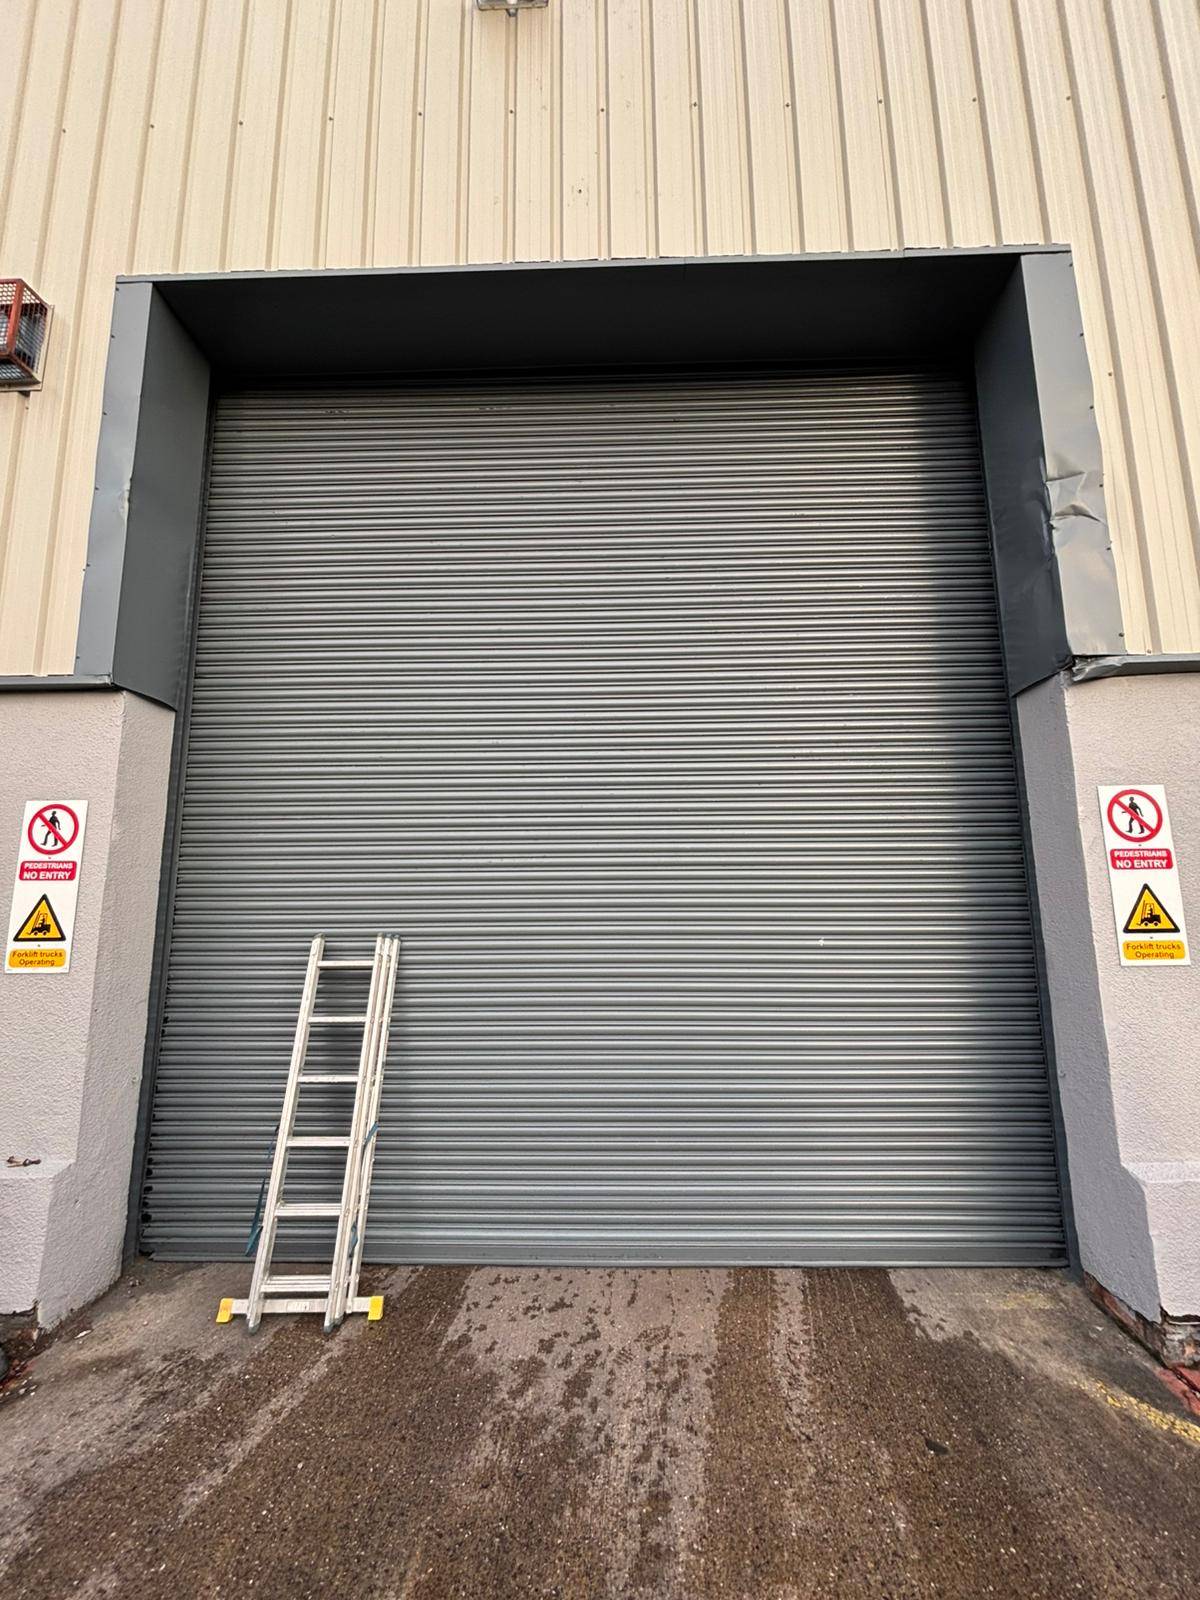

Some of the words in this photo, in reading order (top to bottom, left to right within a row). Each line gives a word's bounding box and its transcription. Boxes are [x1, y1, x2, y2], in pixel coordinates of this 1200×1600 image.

[1116, 859, 1132, 868] NO
[1133, 859, 1167, 868] ENTRY
[23, 871, 38, 879] NO
[39, 871, 71, 880] ENTRY
[1135, 951, 1175, 959] Operating
[19, 958, 55, 966] Operating
